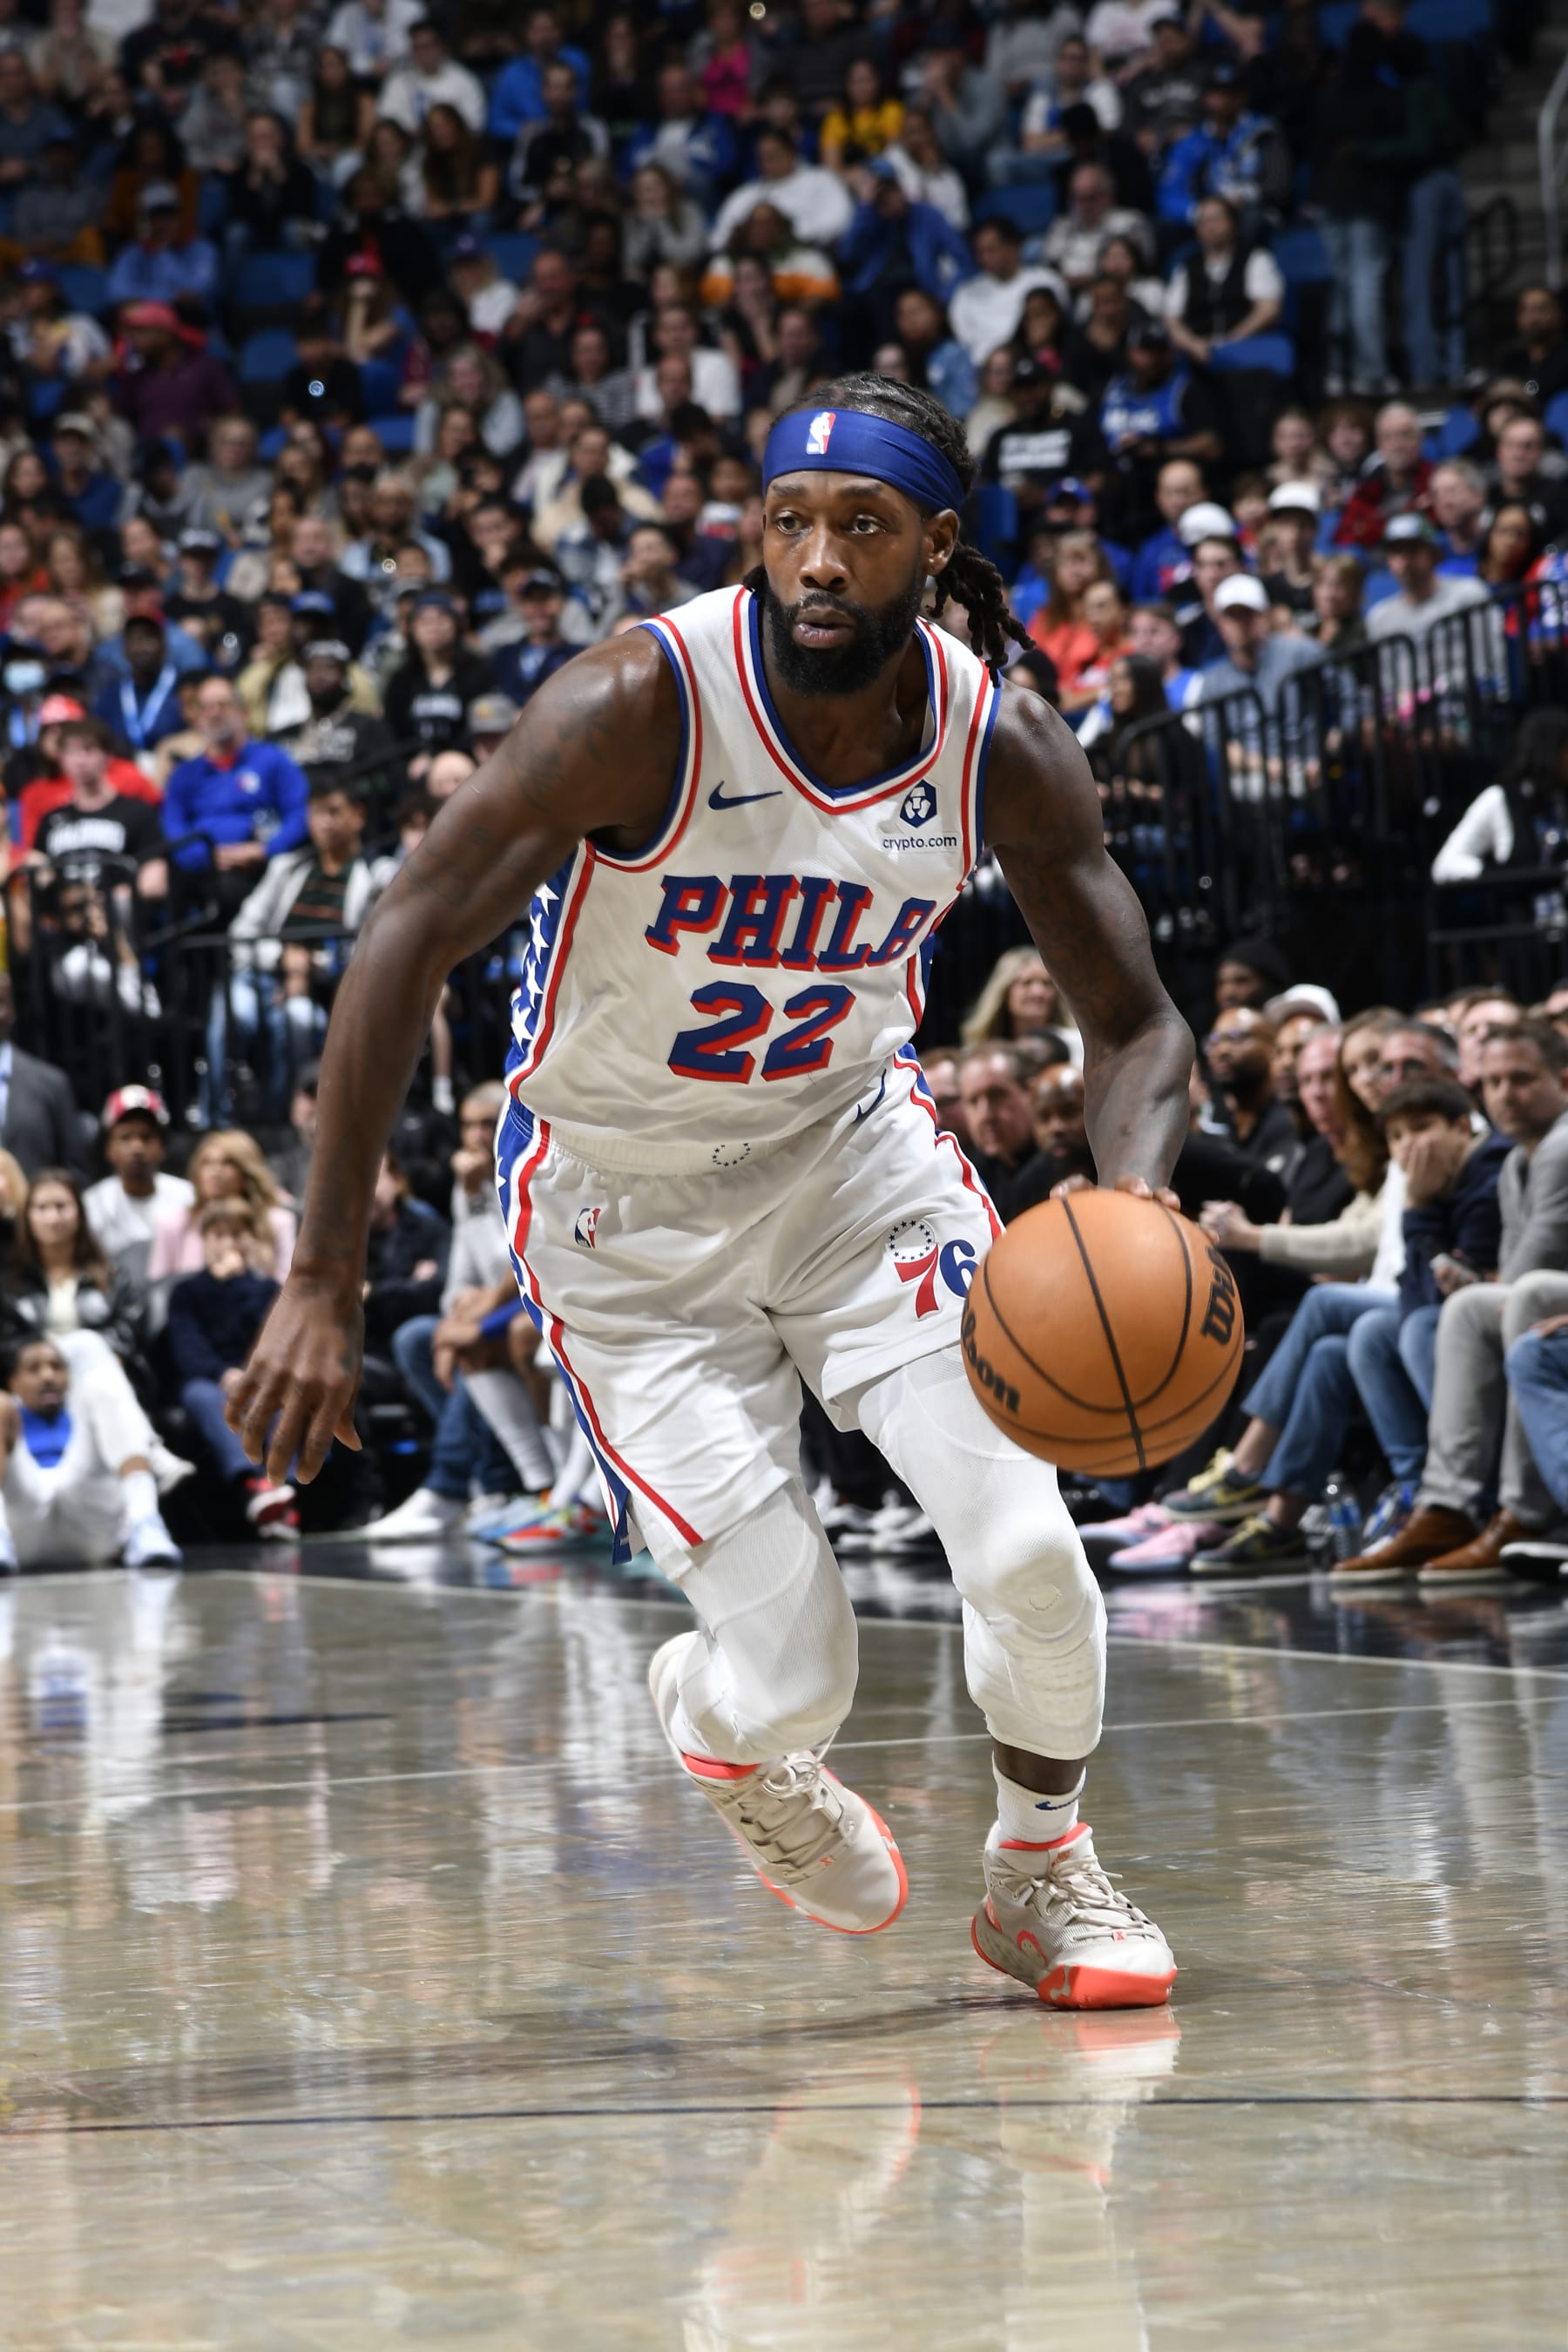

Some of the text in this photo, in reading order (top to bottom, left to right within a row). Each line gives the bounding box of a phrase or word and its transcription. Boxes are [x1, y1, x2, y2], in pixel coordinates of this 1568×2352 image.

[882, 836, 957, 850] crypto.com
[645, 875, 937, 973] PHILA
[668, 981, 856, 1085] 22
[894, 1239, 979, 1320] 76
[1200, 1245, 1235, 1345] Wil
